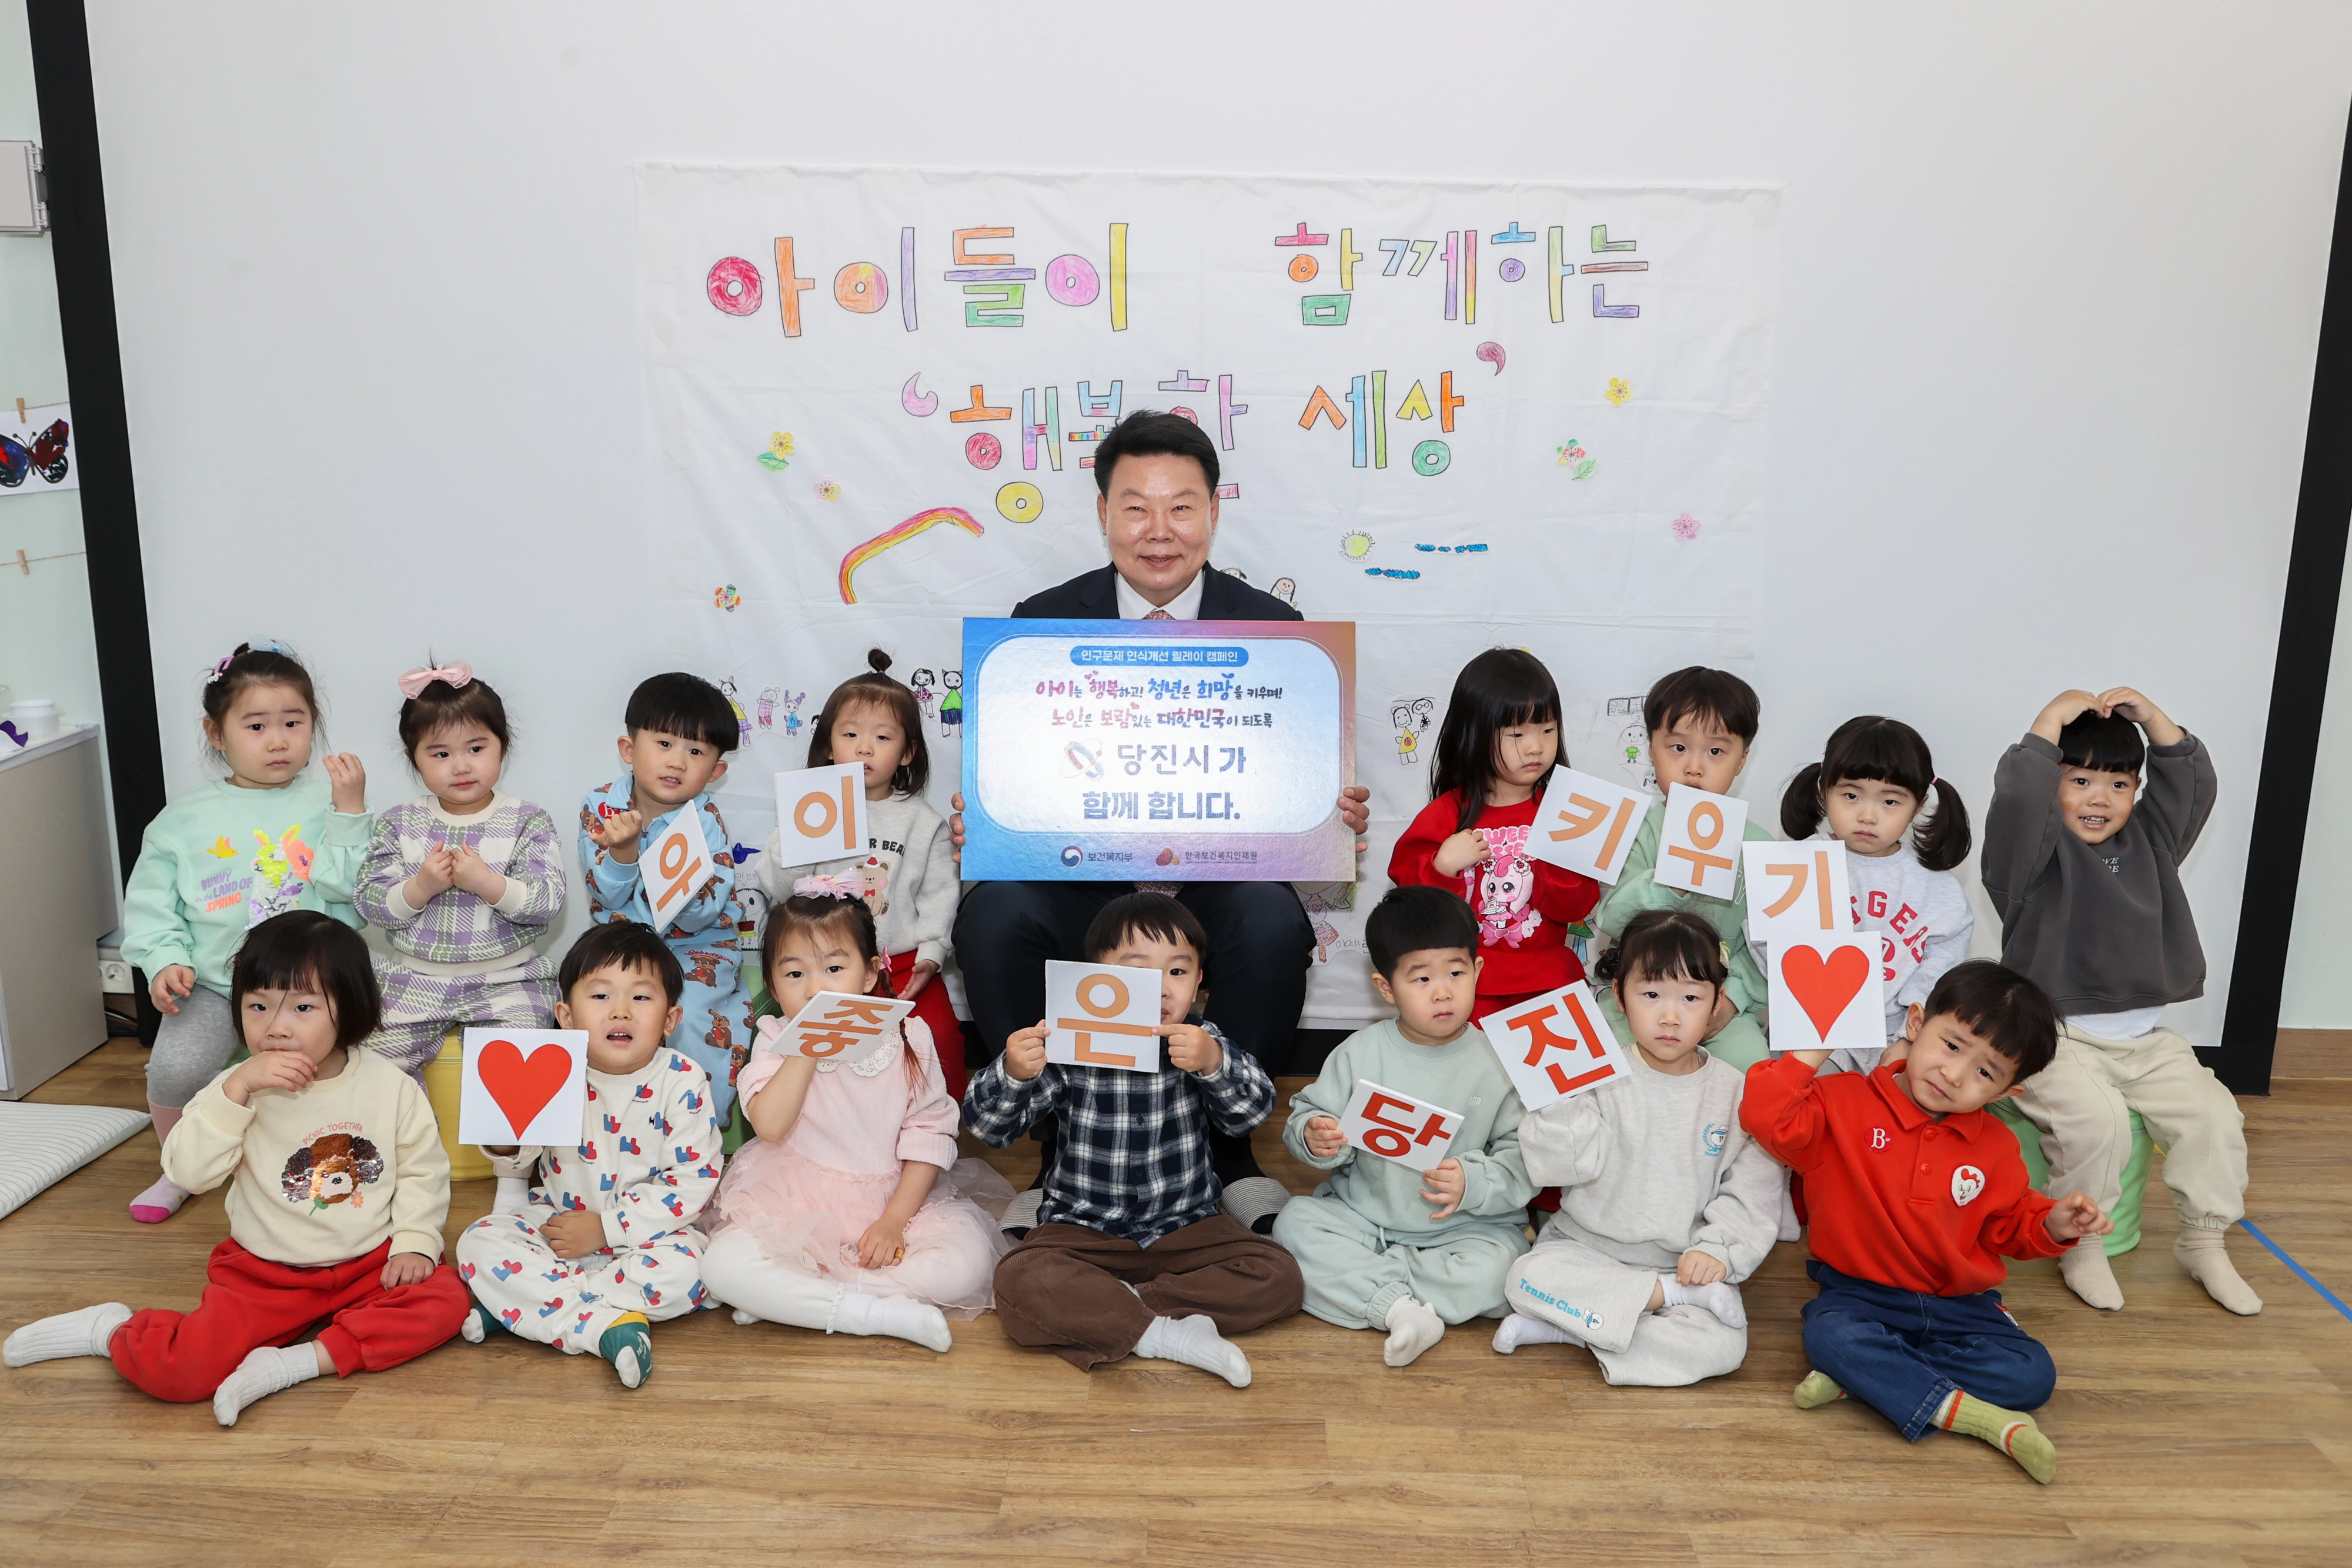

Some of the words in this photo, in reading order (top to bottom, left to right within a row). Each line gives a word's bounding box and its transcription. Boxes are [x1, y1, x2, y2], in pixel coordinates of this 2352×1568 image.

[707, 222, 1129, 337] 아이들이
[1274, 222, 1648, 326] 함께하는
[1081, 651, 1124, 662] 인구문제
[1127, 651, 1169, 662] 인식개선
[1172, 651, 1203, 662] 릴레이
[1207, 651, 1238, 663] 캠페인
[1036, 680, 1082, 698] 아이는
[1089, 680, 1143, 699] 행복하고!
[1148, 678, 1191, 700] 청년은
[1197, 679, 1243, 700] 희망을
[1247, 688, 1282, 699] 키우며!
[1051, 707, 1093, 728] 노인은
[1100, 708, 1152, 728] 보람있는
[1157, 708, 1238, 728] 대한민국이
[1242, 713, 1272, 728] 되도록
[794, 775, 856, 850] 이
[1083, 792, 1138, 820] 함께
[1147, 792, 1241, 820] 합니다.
[1548, 792, 1636, 871] 키
[1668, 801, 1733, 887] 우
[882, 840, 906, 857] BEA
[1088, 852, 1132, 862] 보건복지부
[1185, 851, 1257, 860] 한국보건복지인재원
[201, 871, 232, 891] BUNNY
[213, 881, 238, 898] LAND
[239, 877, 253, 890] OF
[1762, 851, 1833, 930] 기
[205, 891, 242, 912] SPRING
[797, 999, 894, 1058] 좋
[1057, 973, 1153, 1067] 은
[1506, 992, 1616, 1095] 진
[303, 1128, 325, 1145] PICNIC
[327, 1122, 363, 1133] TOGETHER
[1360, 1091, 1451, 1156] 당
[1871, 1128, 1886, 1149] B
[1520, 1278, 1555, 1305] Tennis
[1556, 1299, 1581, 1318] Club
